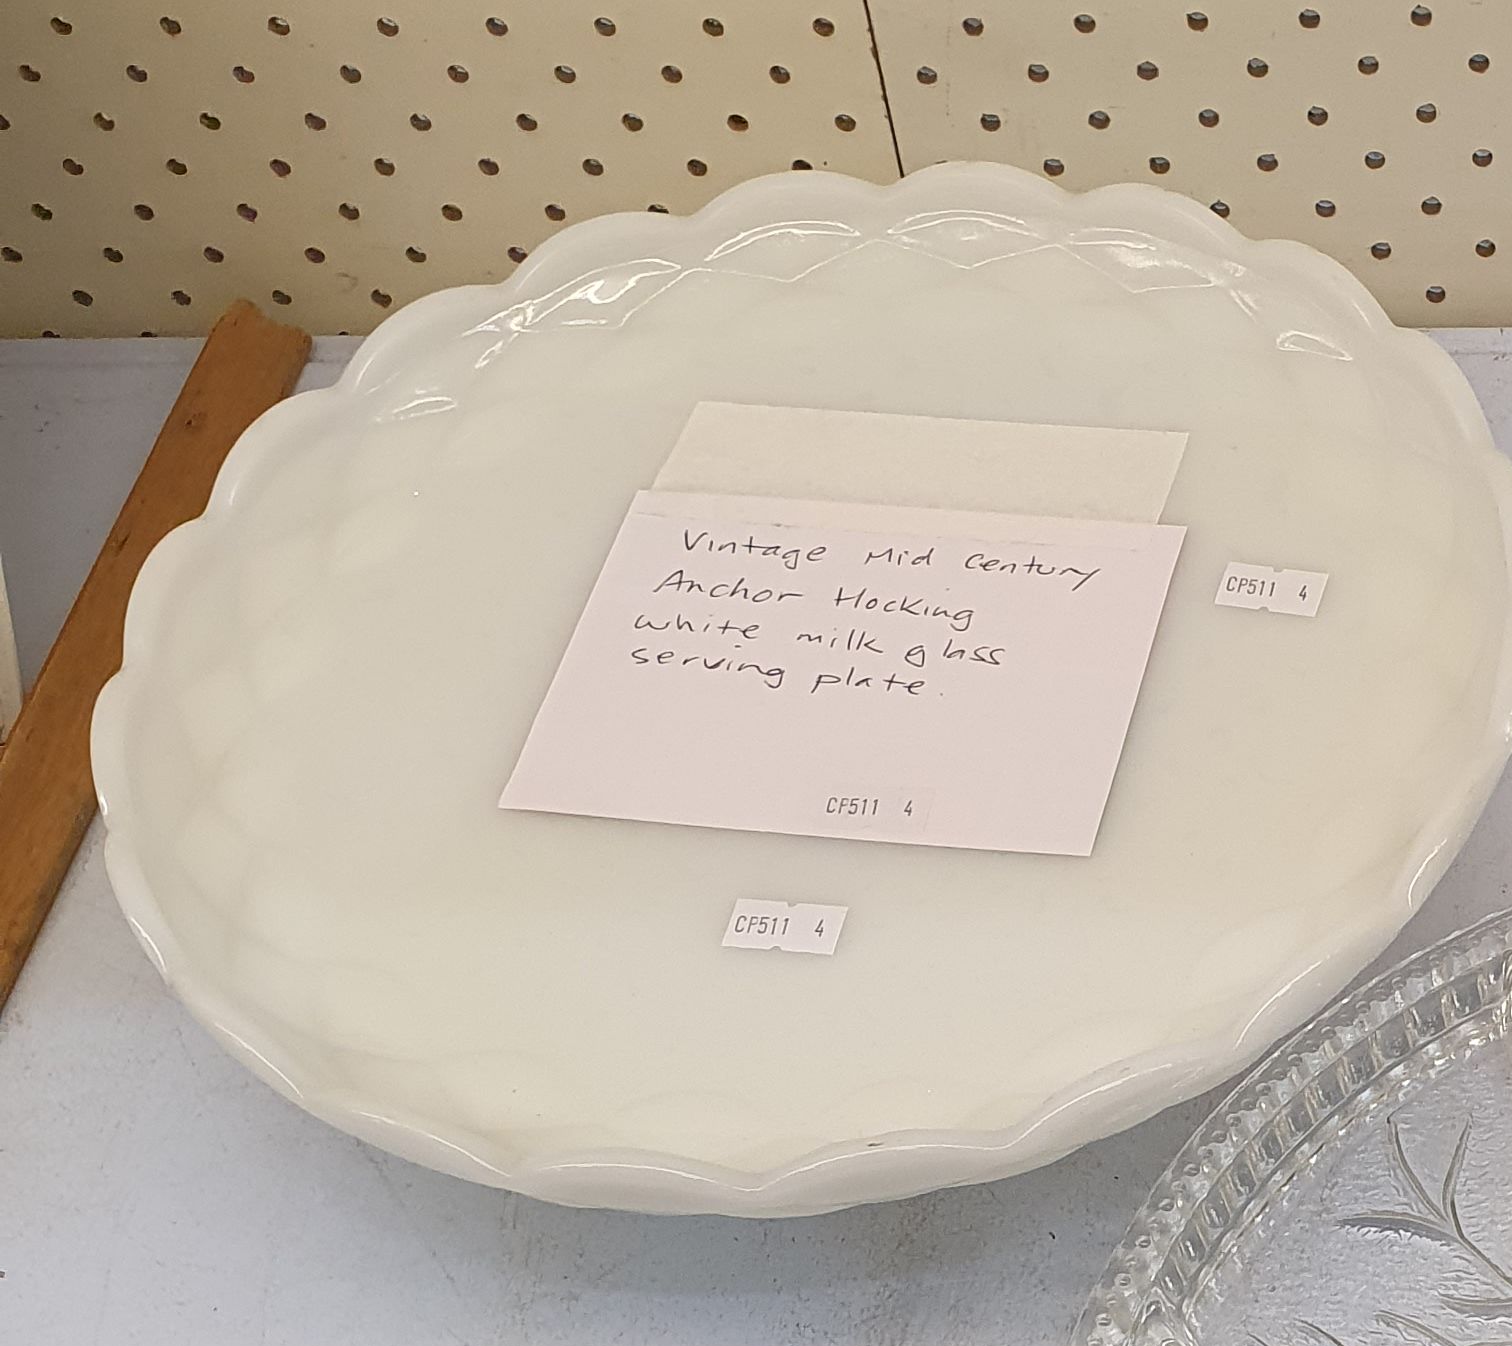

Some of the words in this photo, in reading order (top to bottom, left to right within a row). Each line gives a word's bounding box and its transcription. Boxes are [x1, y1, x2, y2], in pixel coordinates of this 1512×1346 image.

[684, 529, 827, 571] Vintage
[653, 569, 804, 603] Anchor
[834, 587, 975, 631] Hocking
[1226, 576, 1276, 598] CP511
[1299, 584, 1307, 601] 4
[634, 613, 760, 640] white
[797, 628, 884, 654] milk
[631, 645, 786, 689] serving
[903, 799, 913, 817] 4
[814, 918, 824, 938] 4
